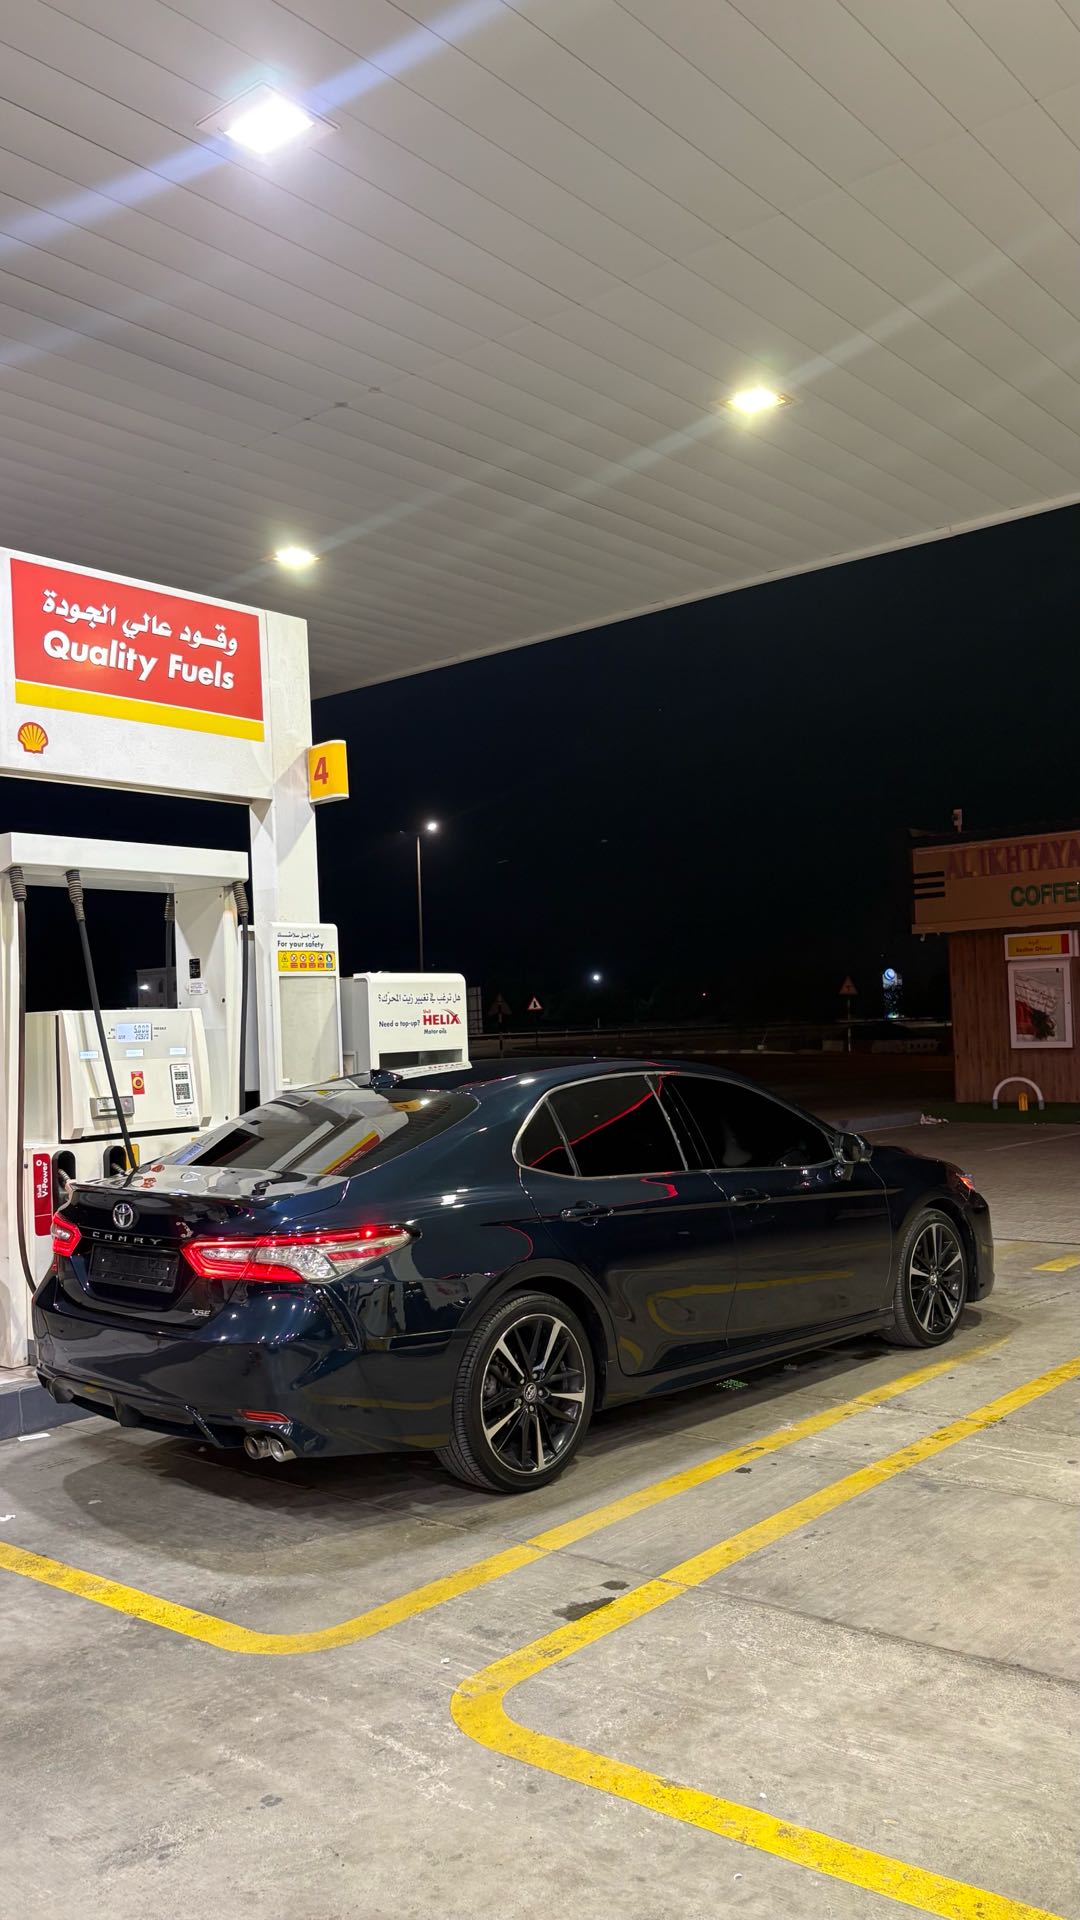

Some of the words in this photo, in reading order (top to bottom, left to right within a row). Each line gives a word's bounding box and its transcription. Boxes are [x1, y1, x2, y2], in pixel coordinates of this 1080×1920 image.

[42, 589, 117, 629] الجودة
[121, 612, 172, 639] عالي
[179, 623, 239, 657] وقود
[43, 630, 158, 682] Quality
[168, 654, 235, 690] Fuels
[313, 757, 329, 784] 4
[1010, 881, 1080, 907] COFFE
[277, 940, 287, 948] For
[289, 941, 304, 949] your
[305, 940, 325, 949] safety
[402, 993, 414, 1005] زيت
[414, 992, 429, 1005] تغيير
[436, 992, 452, 1005] ترغب
[452, 992, 461, 1004] هل
[378, 1020, 394, 1028] Need
[400, 1019, 420, 1029] top-up?
[423, 1014, 461, 1025] HELIX
[41, 1161, 49, 1198] V-Power
[92, 1231, 164, 1245] CAMRY
[189, 1308, 212, 1317] XSE
